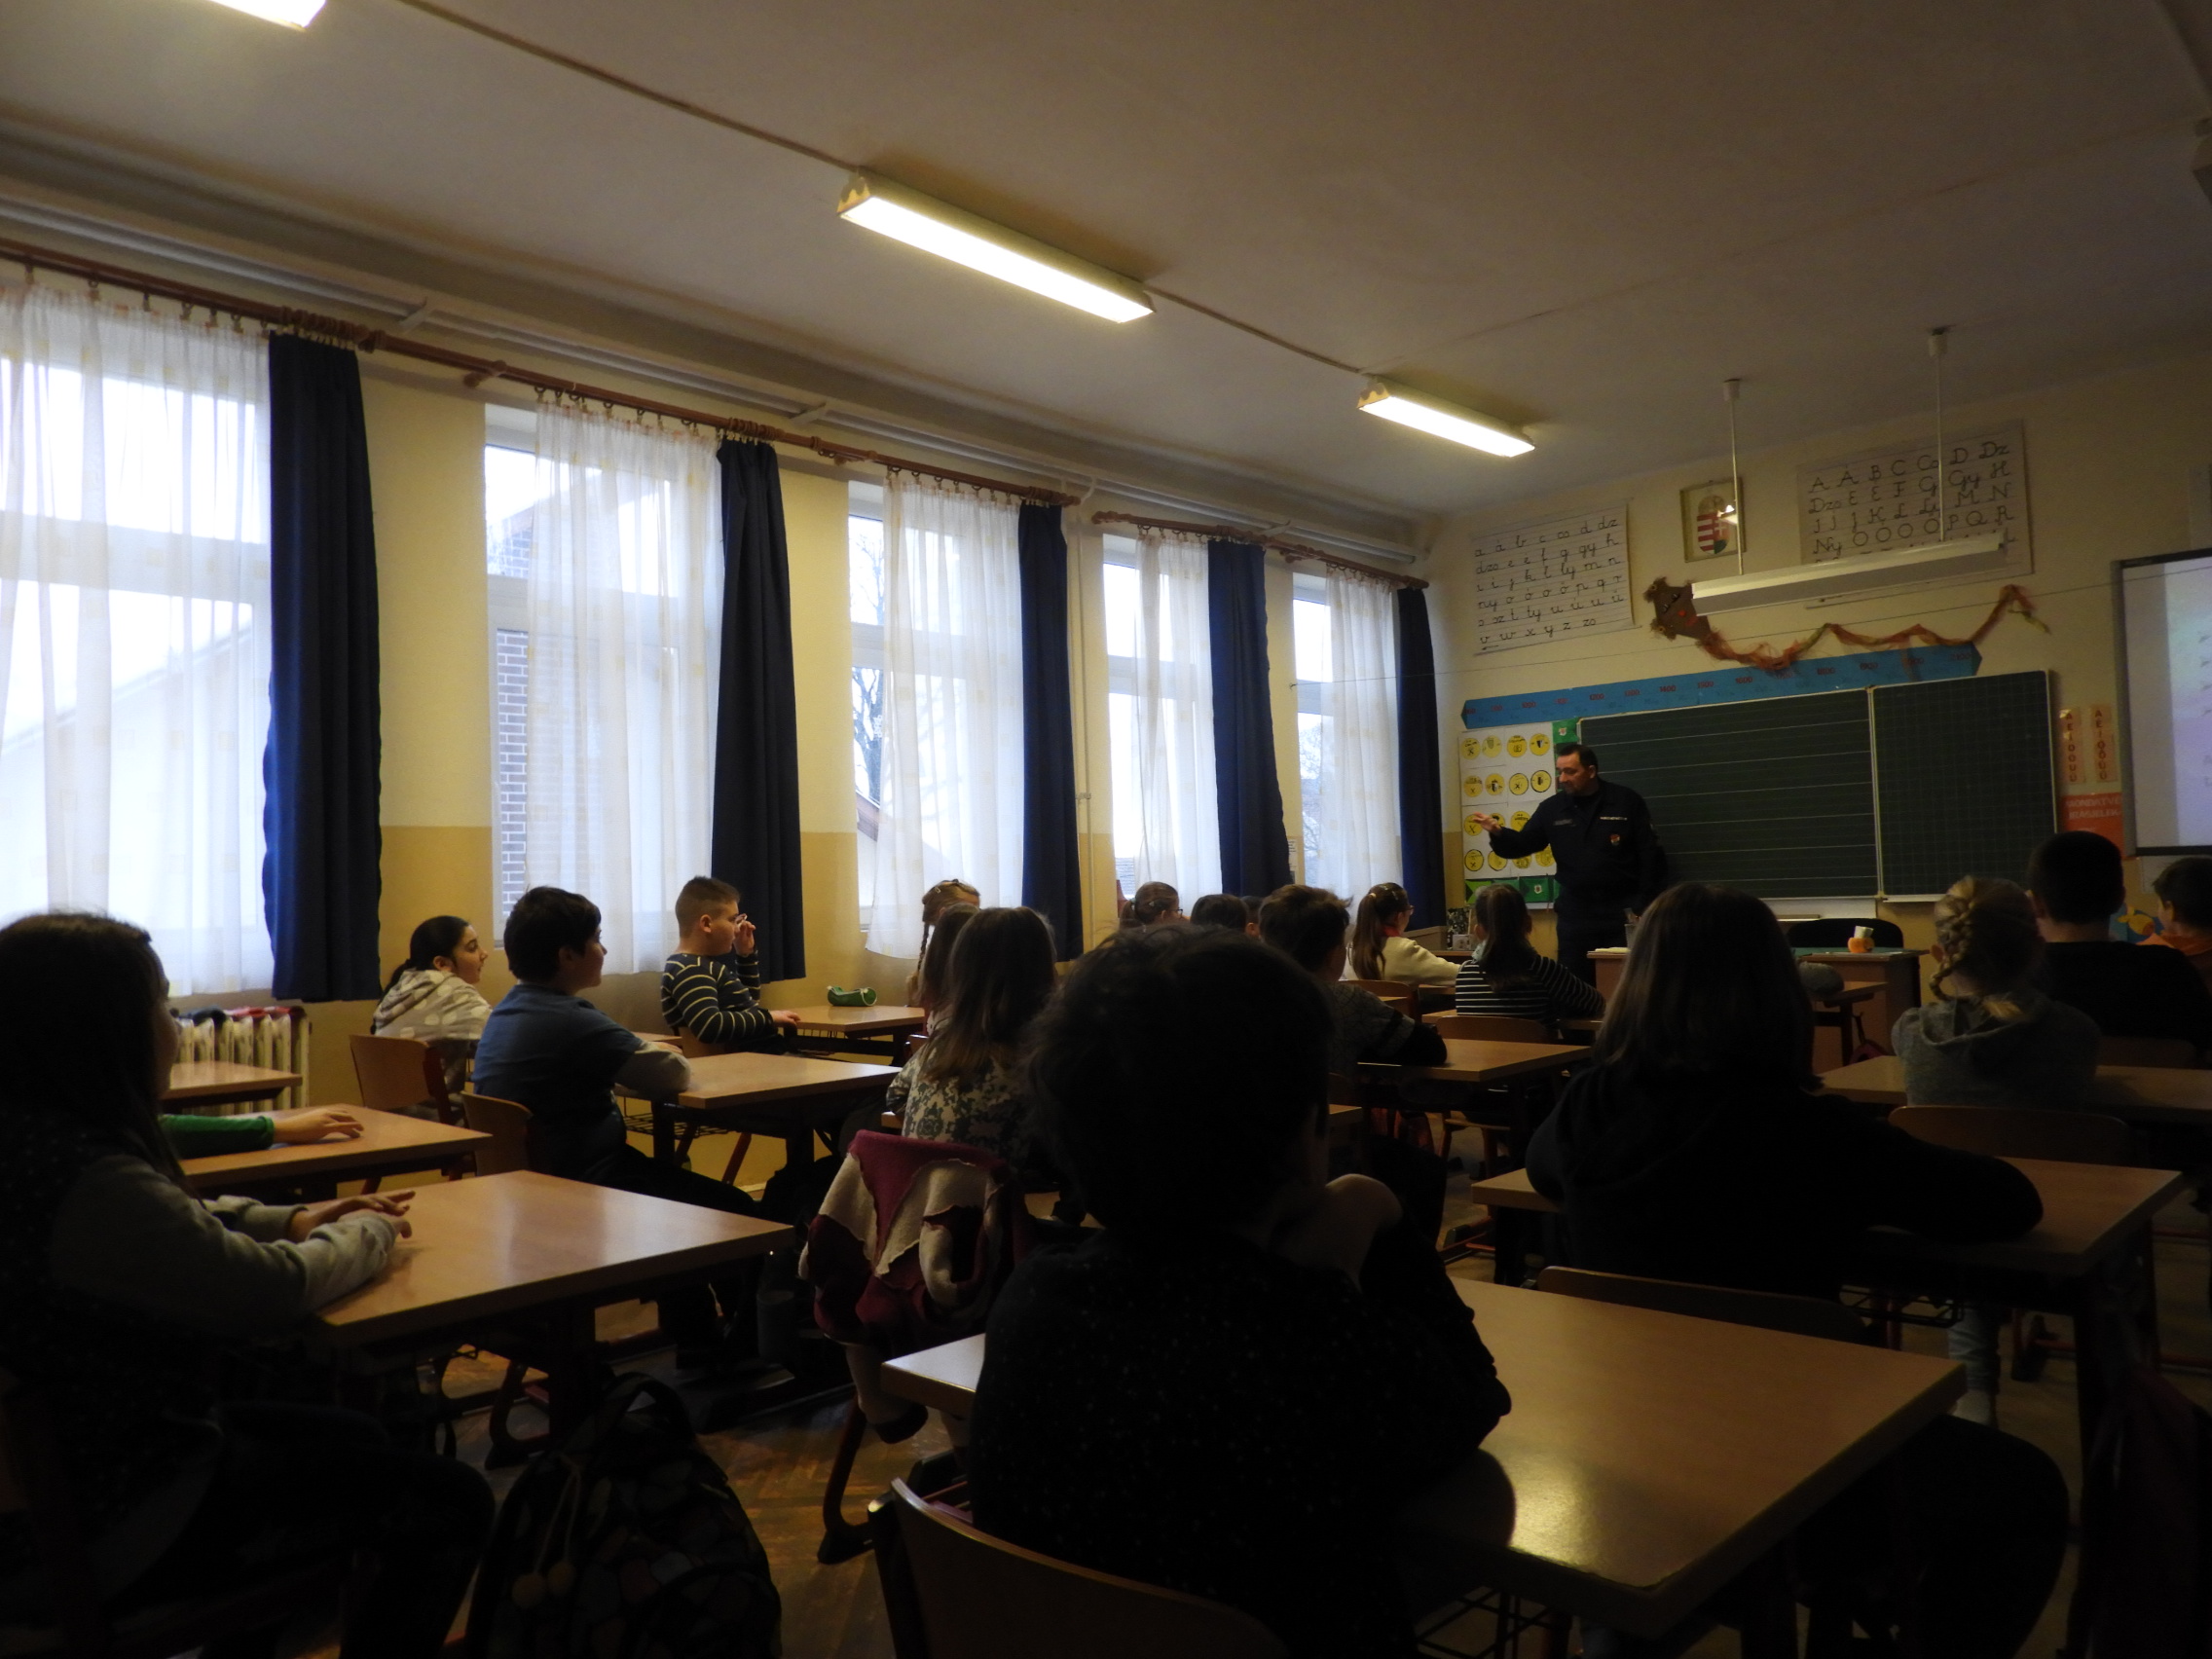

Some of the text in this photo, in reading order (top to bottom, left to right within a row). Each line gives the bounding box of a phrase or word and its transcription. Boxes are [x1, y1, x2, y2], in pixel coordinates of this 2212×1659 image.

[1808, 476, 1830, 494] A
[1868, 464, 1882, 481] B
[1891, 460, 1906, 476] C
[1950, 447, 1969, 464] D
